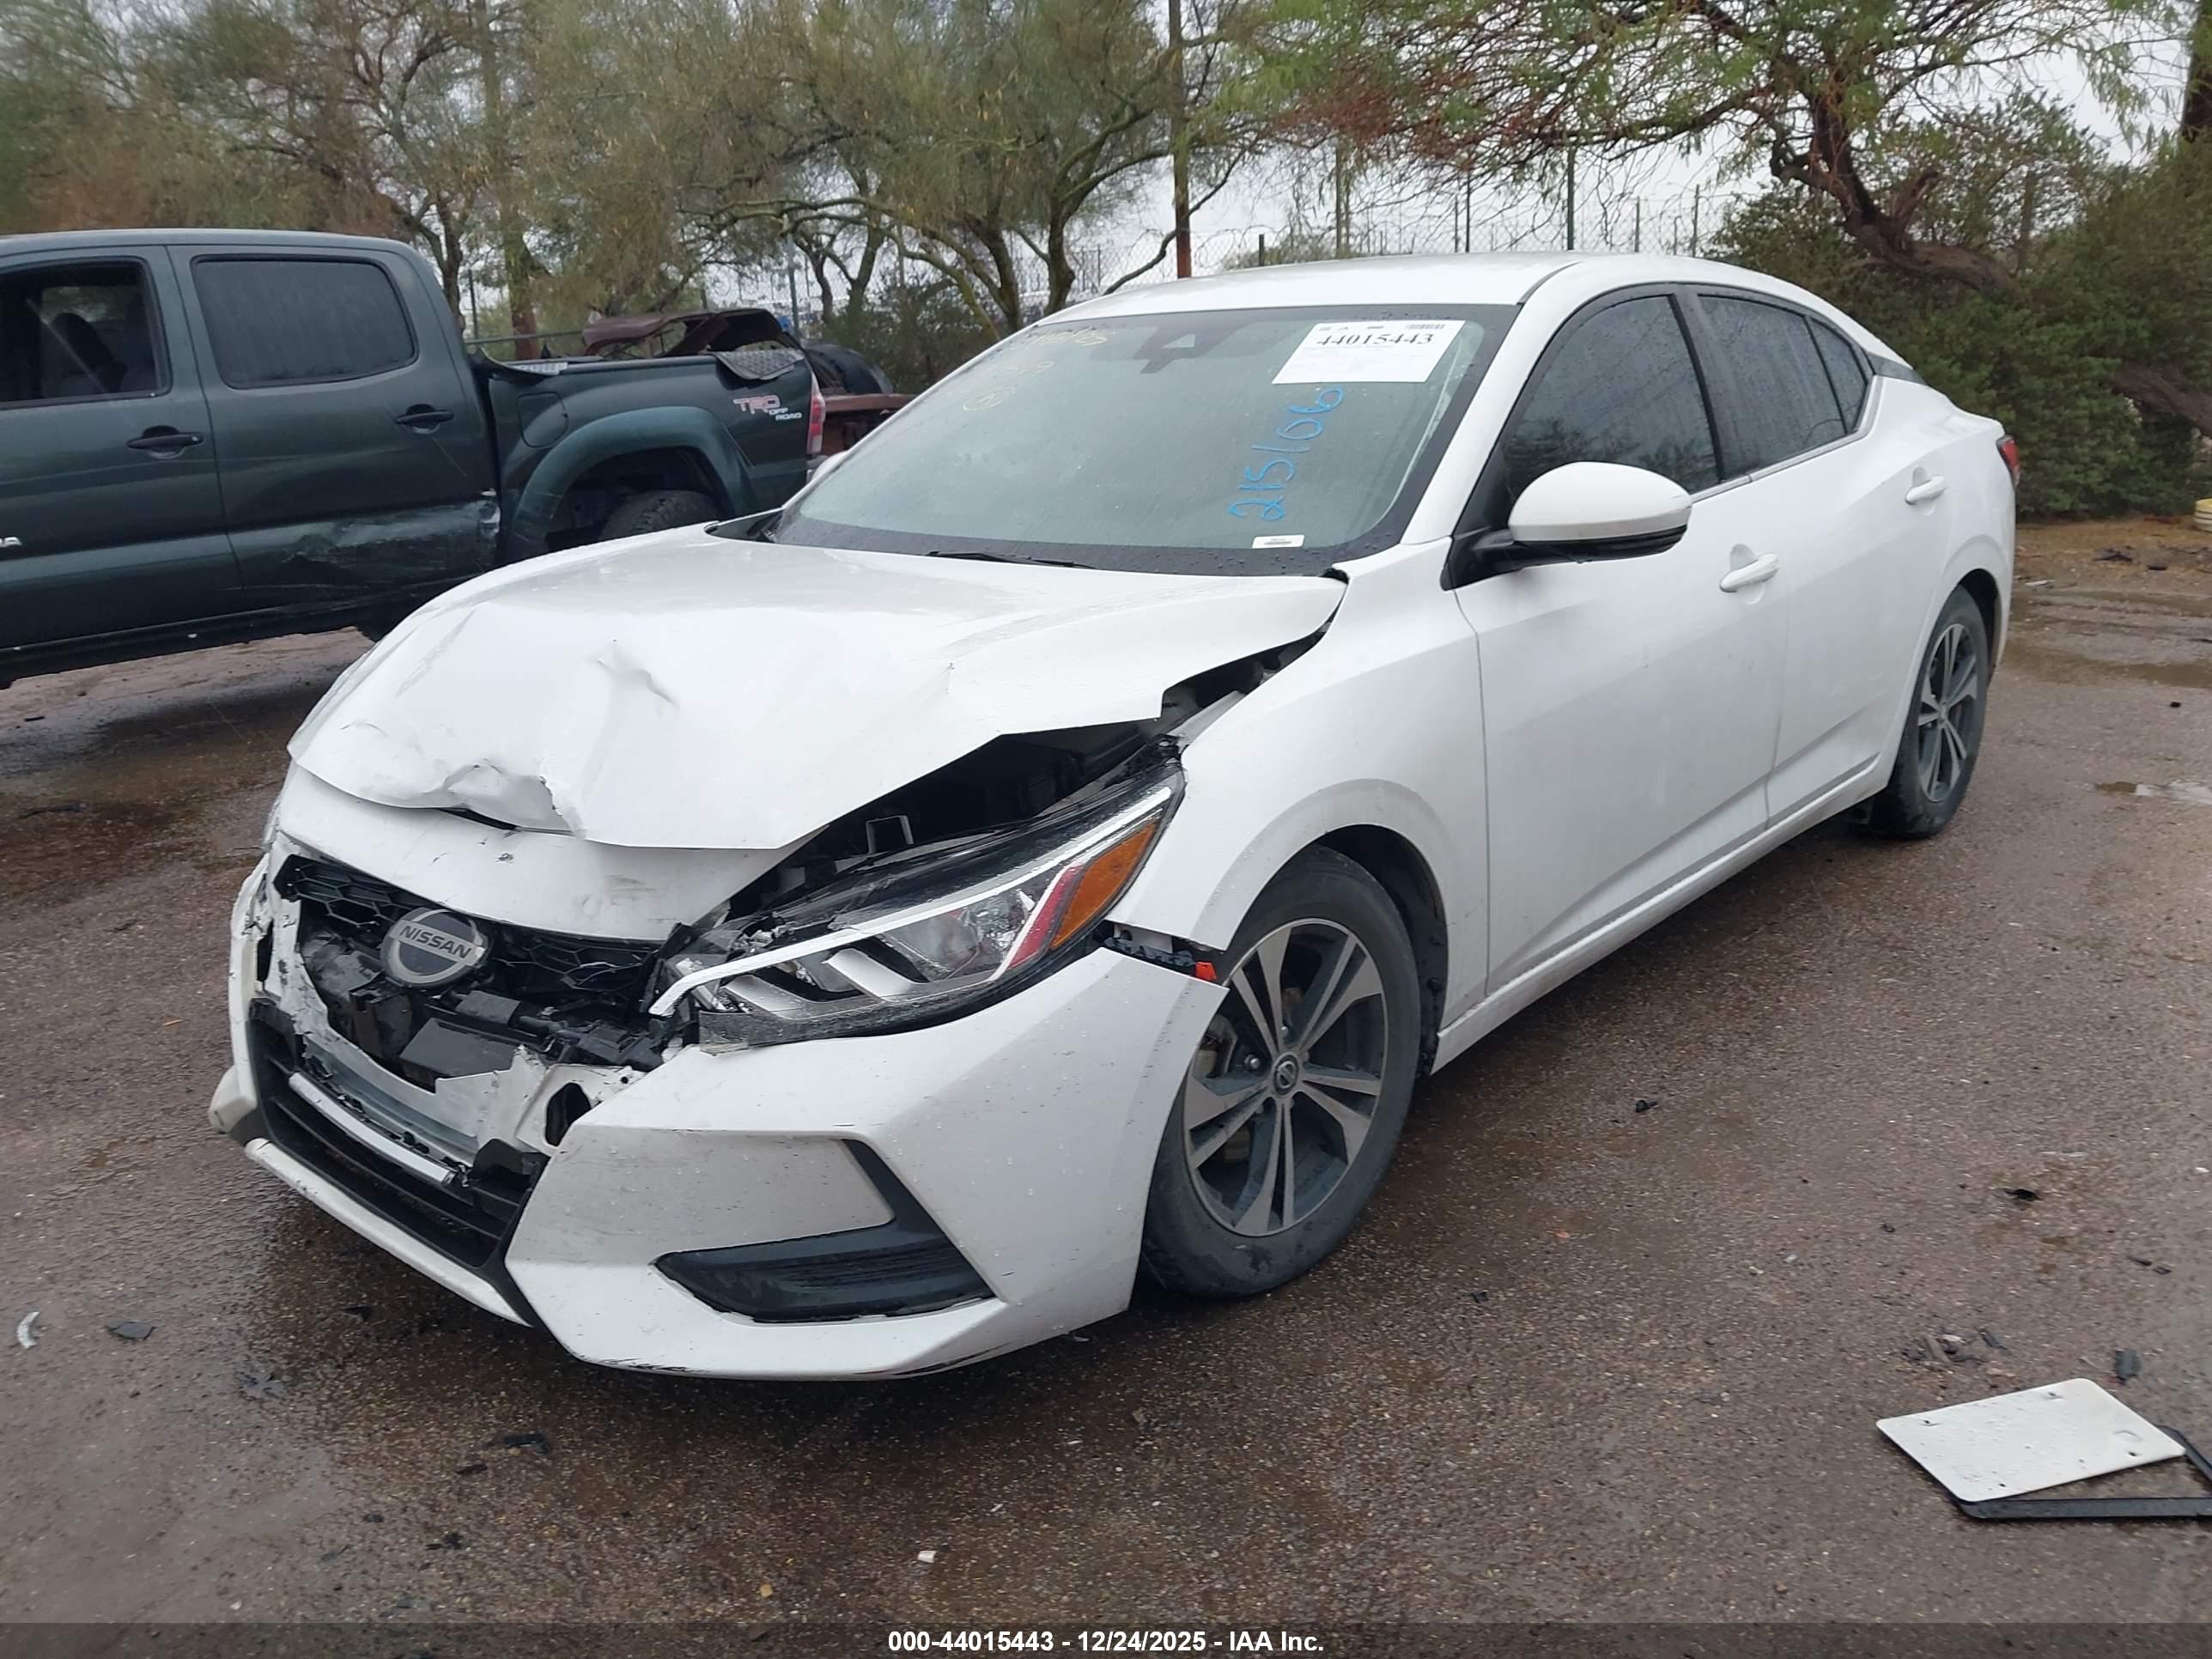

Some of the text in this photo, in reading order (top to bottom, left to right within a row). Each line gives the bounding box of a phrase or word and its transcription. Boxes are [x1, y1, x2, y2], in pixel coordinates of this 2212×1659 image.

[1316, 333, 1434, 346] 44015443
[732, 394, 781, 414] TRD
[769, 407, 788, 416] OFF
[399, 925, 472, 959] NISSAN
